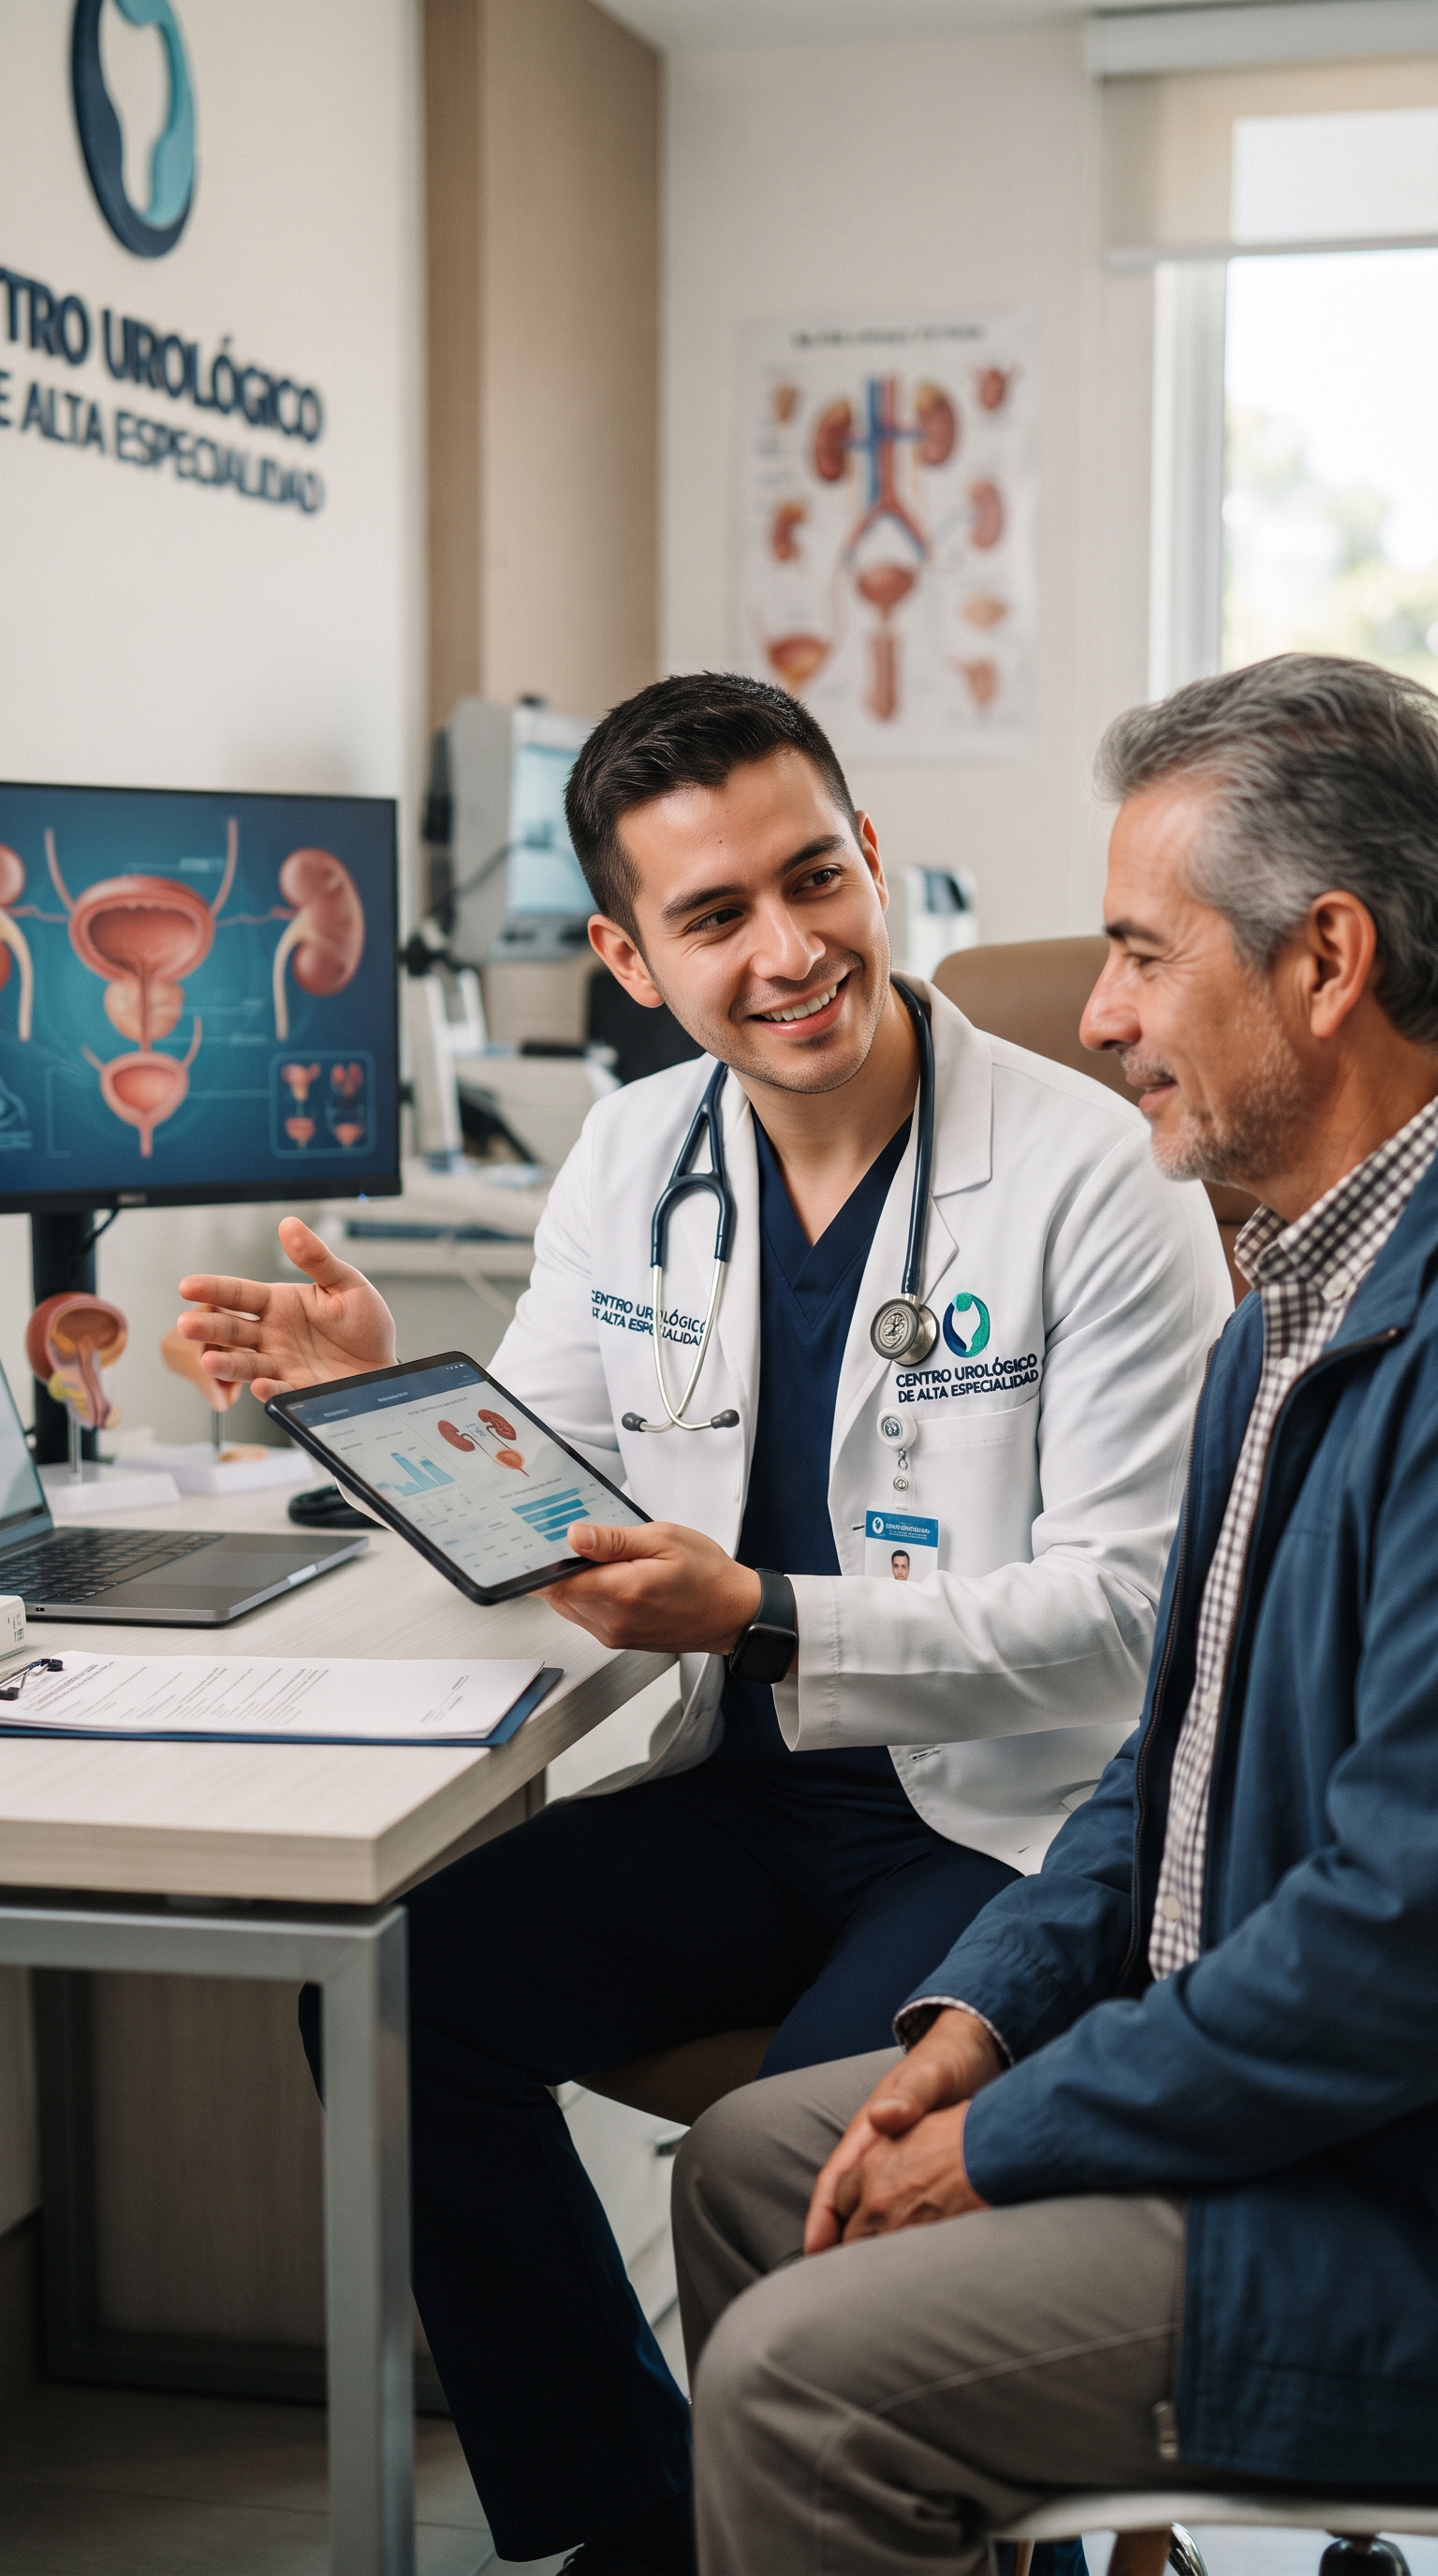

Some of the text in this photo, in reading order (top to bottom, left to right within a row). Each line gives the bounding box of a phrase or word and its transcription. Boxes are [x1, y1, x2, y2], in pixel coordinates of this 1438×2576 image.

[102, 308, 323, 443] UROLÓGICO
[22, 381, 107, 455] ALTA
[116, 410, 325, 514] ESPECIALIDAD
[600, 1310, 626, 1328] ALTA
[896, 1353, 1038, 1388] CENTRO UROLÓGICO
[898, 1368, 1039, 1403] DE ALTA ESPECIALIDAD
